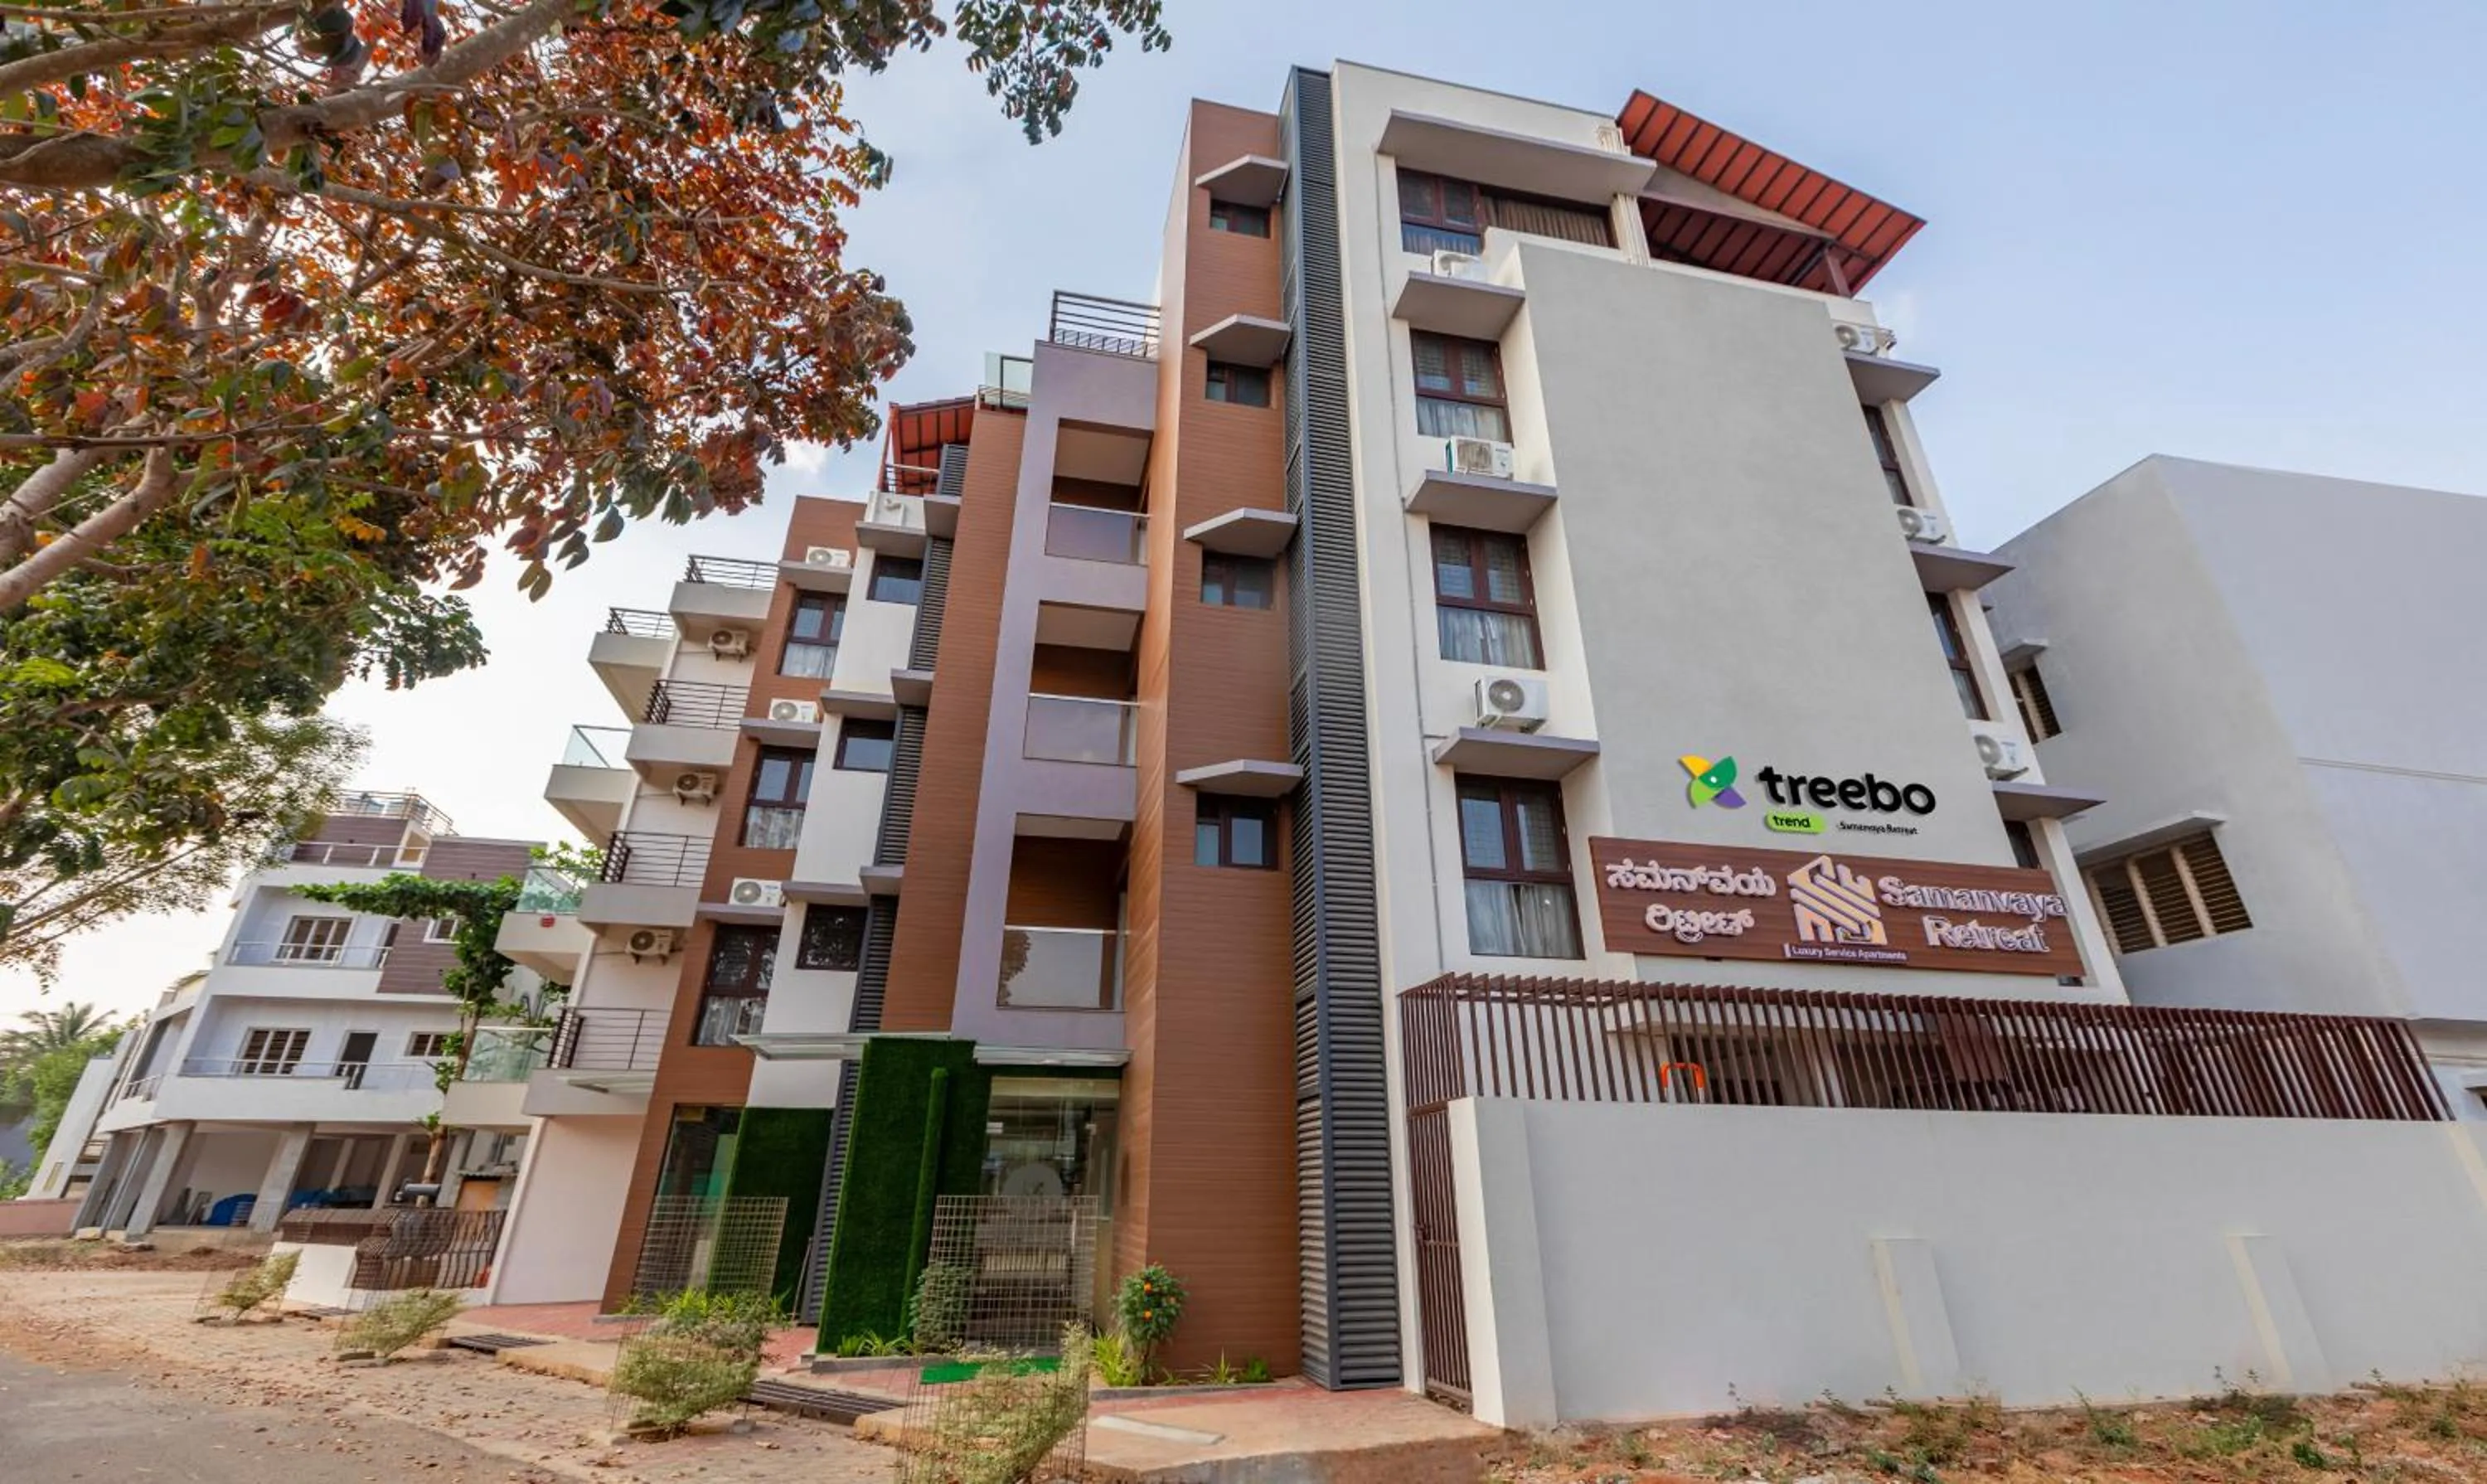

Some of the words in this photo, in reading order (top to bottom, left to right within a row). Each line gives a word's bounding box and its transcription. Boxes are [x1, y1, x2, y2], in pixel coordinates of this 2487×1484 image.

[1758, 766, 1936, 815] treebo
[1772, 815, 1811, 828] trend
[1878, 875, 2068, 923] Samanvaya
[1791, 945, 1823, 958] Luxury
[1824, 947, 1857, 958] Service
[1858, 948, 1907, 961] Apartments
[1922, 914, 2051, 953] Retreat
